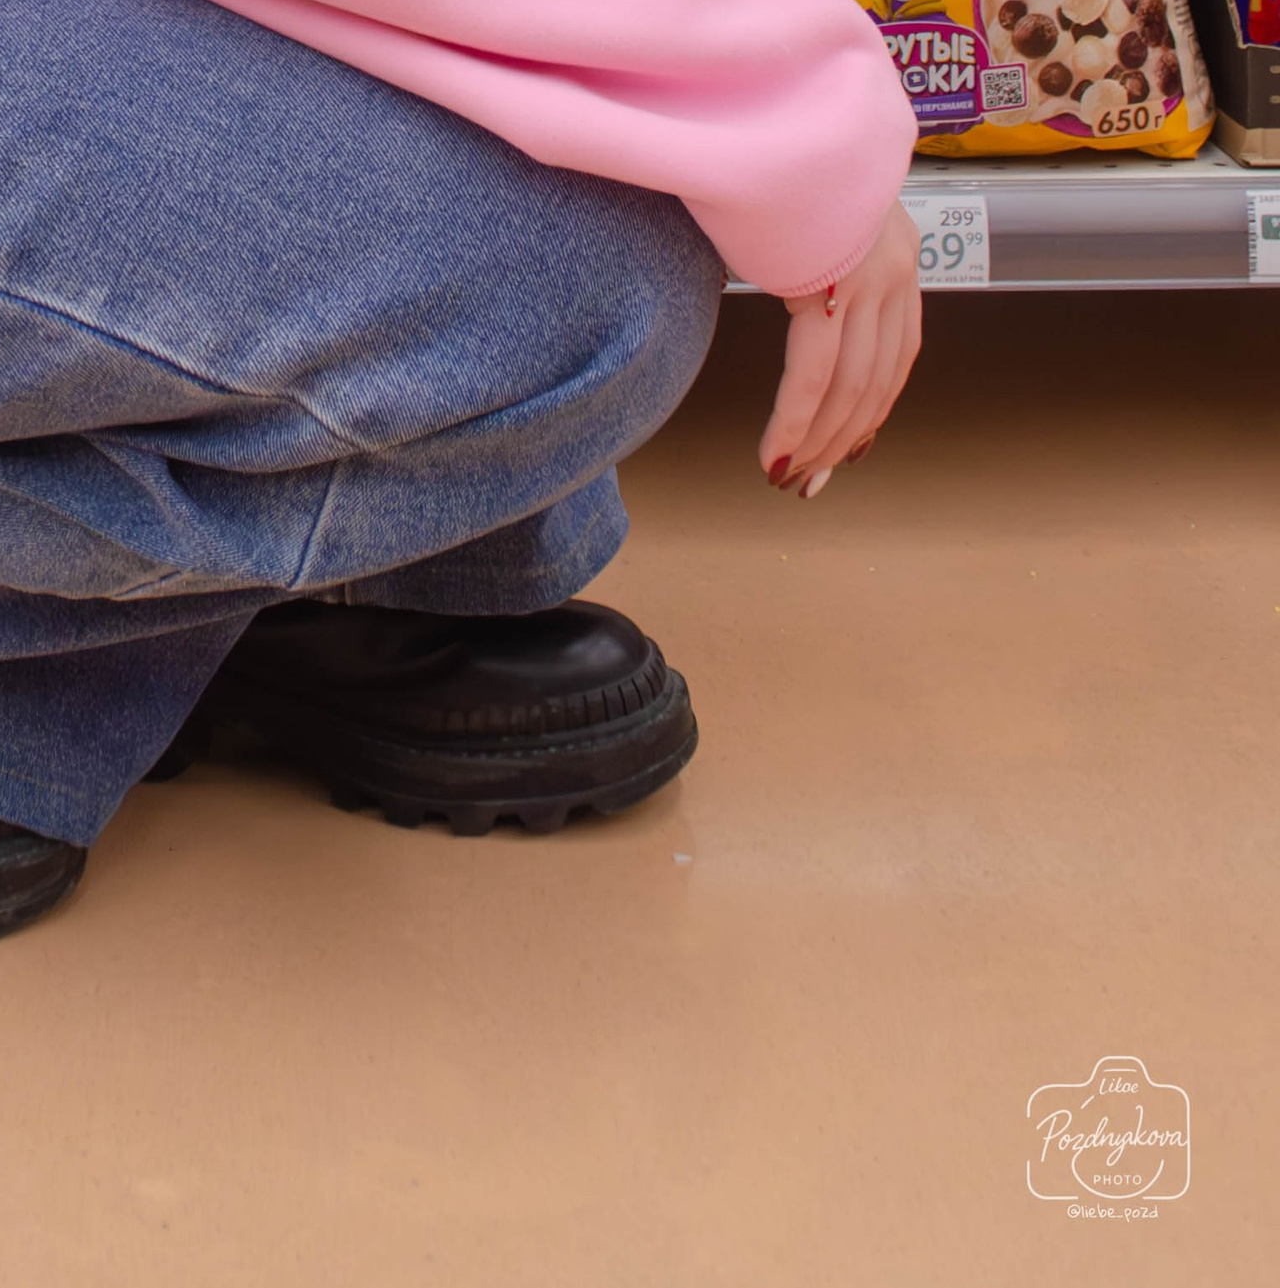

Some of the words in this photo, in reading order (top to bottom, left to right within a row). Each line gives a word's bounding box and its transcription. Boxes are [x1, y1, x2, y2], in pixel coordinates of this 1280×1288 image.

[886, 32, 975, 65] РУТЫЕ
[902, 65, 975, 93] ОКИ
[1098, 107, 1150, 134] 650
[940, 210, 974, 226] 299
[918, 233, 965, 271] 69
[966, 232, 983, 245] 99
